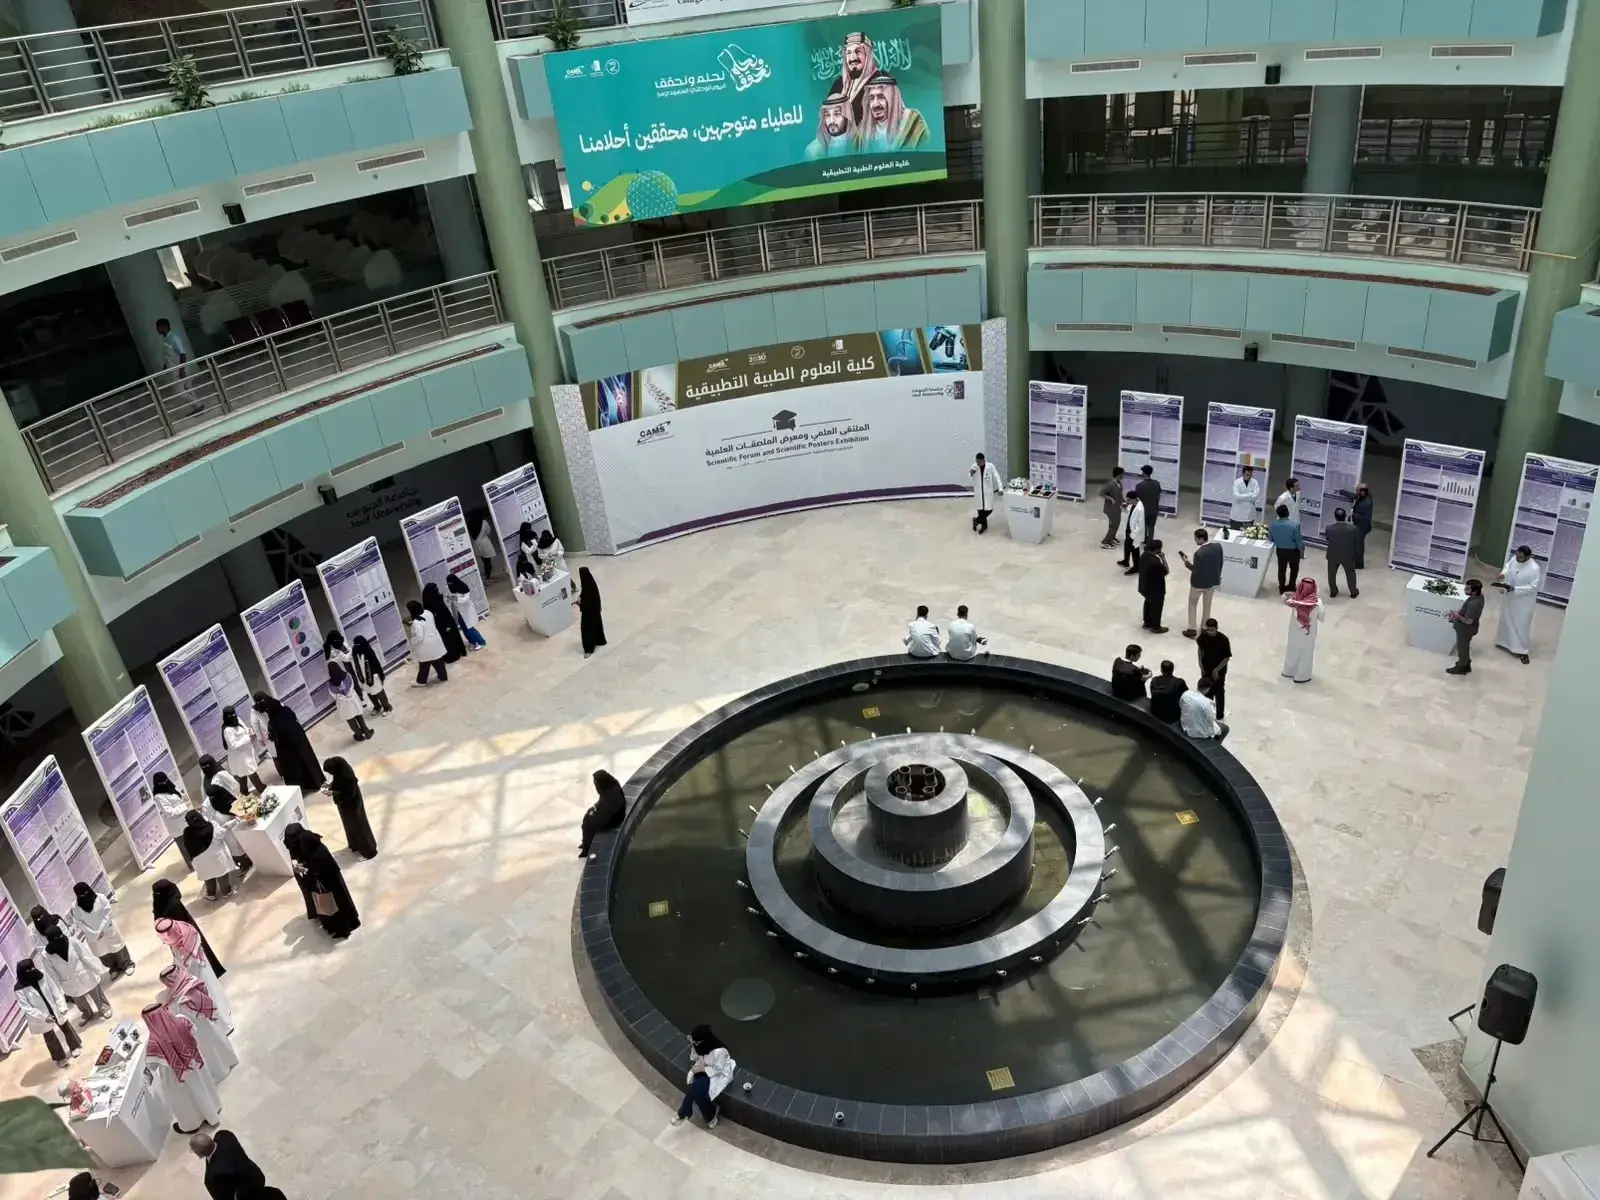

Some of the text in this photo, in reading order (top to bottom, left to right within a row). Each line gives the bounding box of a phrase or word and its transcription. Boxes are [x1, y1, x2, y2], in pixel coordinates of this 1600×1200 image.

[655, 70, 725, 89] نحلم ونحقق
[760, 104, 803, 132] للعلياء
[579, 123, 631, 153] أحلامنا
[635, 123, 689, 151] محققين
[822, 159, 910, 178] كلية العلوم الطبية التطبيقية
[685, 356, 875, 400] كلية العلوم الطبية التطبيقية
[640, 425, 665, 438] CAMS
[811, 427, 838, 440] العلمي
[839, 423, 870, 435] الملتقى
[779, 433, 809, 445] ومعرض
[705, 444, 734, 457] العلمية
[706, 455, 738, 466] Scientific
[739, 451, 761, 460] Forum
[762, 448, 775, 456] and
[775, 442, 807, 454] Scientific
[808, 440, 835, 448] Posters
[836, 435, 870, 445] Exhibition
